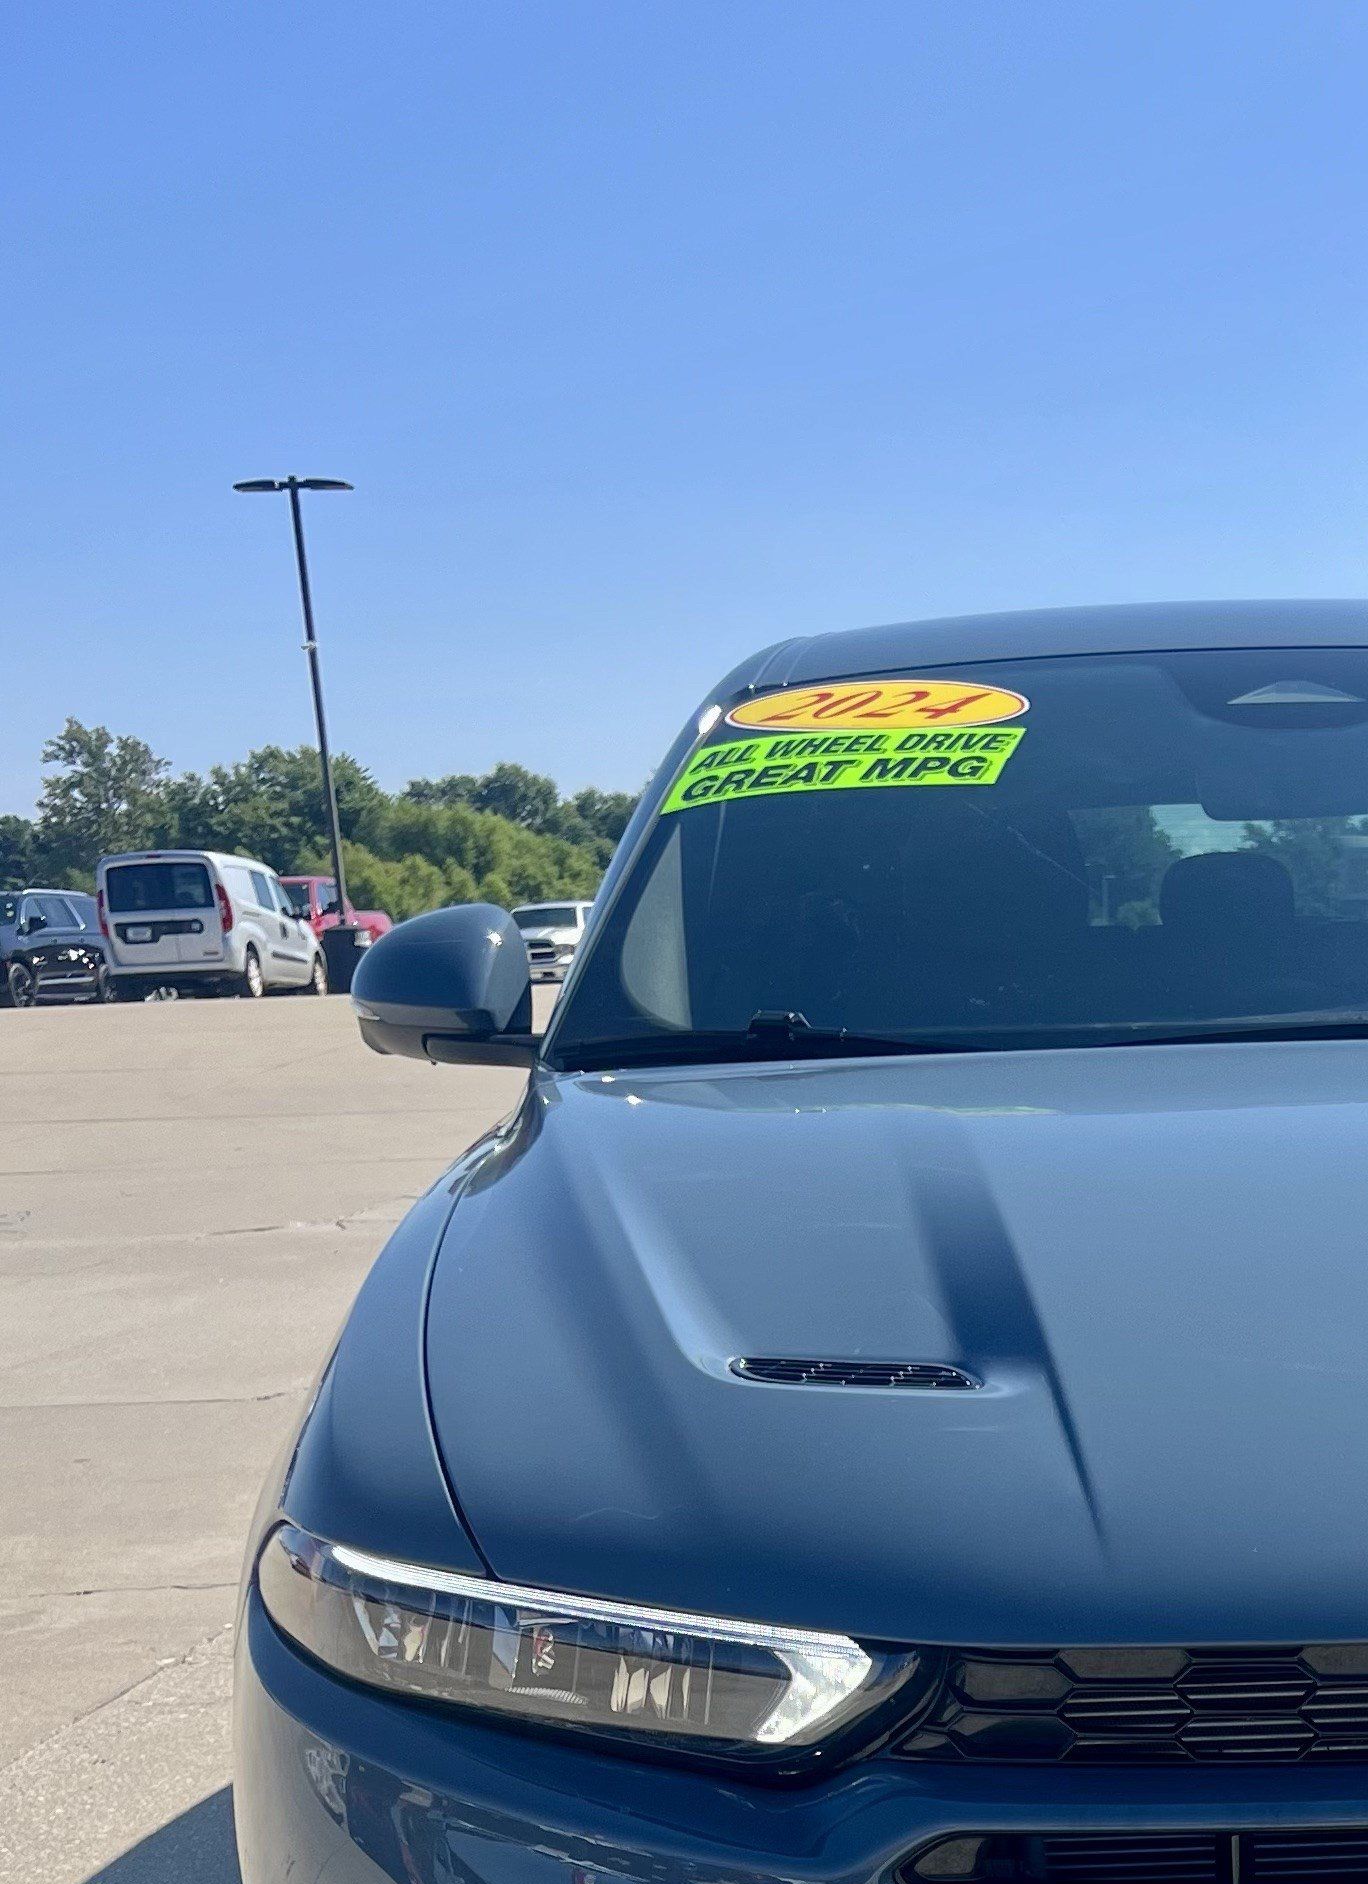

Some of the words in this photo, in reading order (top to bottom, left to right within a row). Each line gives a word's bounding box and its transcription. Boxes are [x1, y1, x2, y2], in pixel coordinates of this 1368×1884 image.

[757, 690, 992, 723] 2024
[690, 744, 760, 776] ALL
[764, 734, 892, 763] WHEEL
[895, 732, 1017, 754] DRIVE
[681, 759, 858, 803] GREAT
[860, 756, 989, 784] MPG
